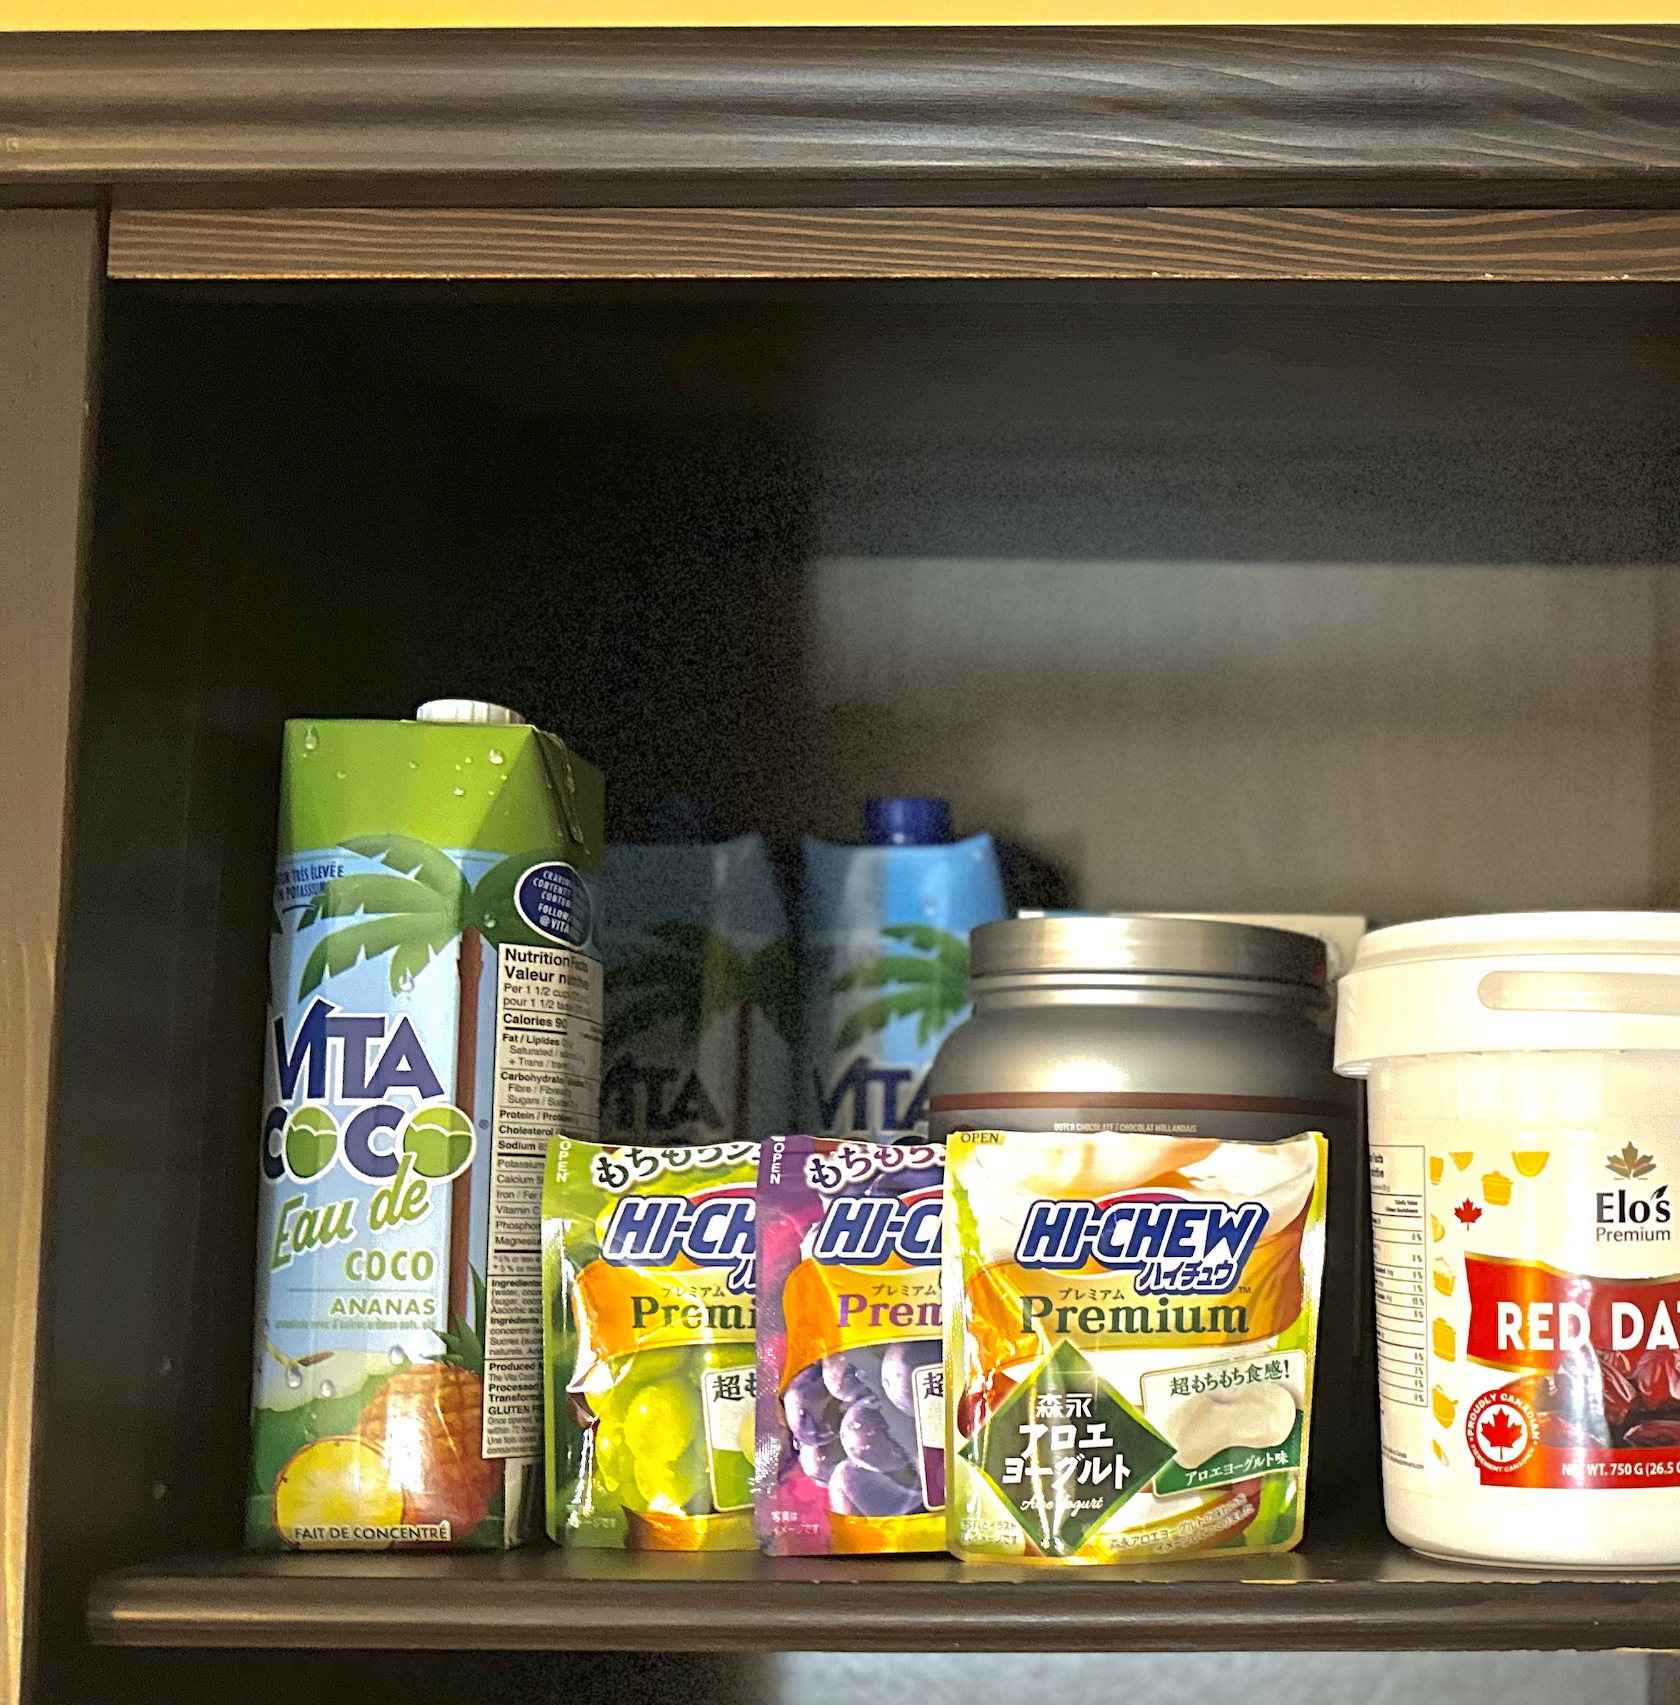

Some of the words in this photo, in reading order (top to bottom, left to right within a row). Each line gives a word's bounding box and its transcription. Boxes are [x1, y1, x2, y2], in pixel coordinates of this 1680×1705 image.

[505, 948, 570, 967] Nutrition
[504, 965, 555, 983] Valeur
[503, 982, 522, 994] Per
[503, 998, 527, 1008] pour
[503, 1013, 553, 1028] Calories
[503, 1033, 519, 1043] Fat
[526, 1035, 560, 1047] Lipides
[272, 999, 445, 1100] VITA
[518, 1057, 544, 1068] Trans
[508, 1083, 532, 1093] Fibre
[500, 1109, 535, 1120] Protein
[499, 1125, 554, 1136] Cholesterol
[1119, 1123, 1153, 1133] CHOCOLAT
[262, 1106, 475, 1182] COCO
[499, 1141, 536, 1151] Sodium
[961, 1132, 999, 1144] OPEN
[556, 1141, 572, 1183] OPEN
[770, 1143, 786, 1184] OPEN
[497, 1174, 535, 1184] Calcium
[496, 1190, 515, 1200] Iron
[270, 1198, 354, 1270] Eau
[370, 1154, 432, 1233] de
[496, 1206, 531, 1216] Vitamin
[819, 1203, 942, 1254] HI-C
[1021, 1206, 1257, 1260] HI-CHEW
[1596, 1226, 1671, 1242] Premium
[344, 1250, 434, 1282] COCO
[1139, 1260, 1235, 1289] ハイチュウ
[871, 1284, 937, 1297] プレミアム
[1059, 1288, 1125, 1301] プレミアム
[329, 1299, 436, 1317] ANANAS
[1020, 1295, 1249, 1335] Premium
[1497, 1301, 1591, 1350] RED
[489, 1363, 535, 1372] Produced
[488, 1406, 530, 1416] GLUTEN
[1036, 1392, 1093, 1418] 森永
[1467, 1393, 1497, 1436] PROUDLY
[1500, 1393, 1540, 1440] CANADIAN
[1019, 1423, 1114, 1460] アロエ
[1002, 1453, 1131, 1491] ヨーグルト
[1184, 1450, 1290, 1487] アロエヨーグルト味
[1587, 1463, 1608, 1476] WT.
[1610, 1463, 1632, 1476] 750
[1634, 1463, 1643, 1475] G
[1645, 1461, 1674, 1477] (26.5
[295, 1527, 324, 1539] FAIT
[330, 1527, 349, 1539] DE
[353, 1523, 448, 1540] CONCENTRÉ
